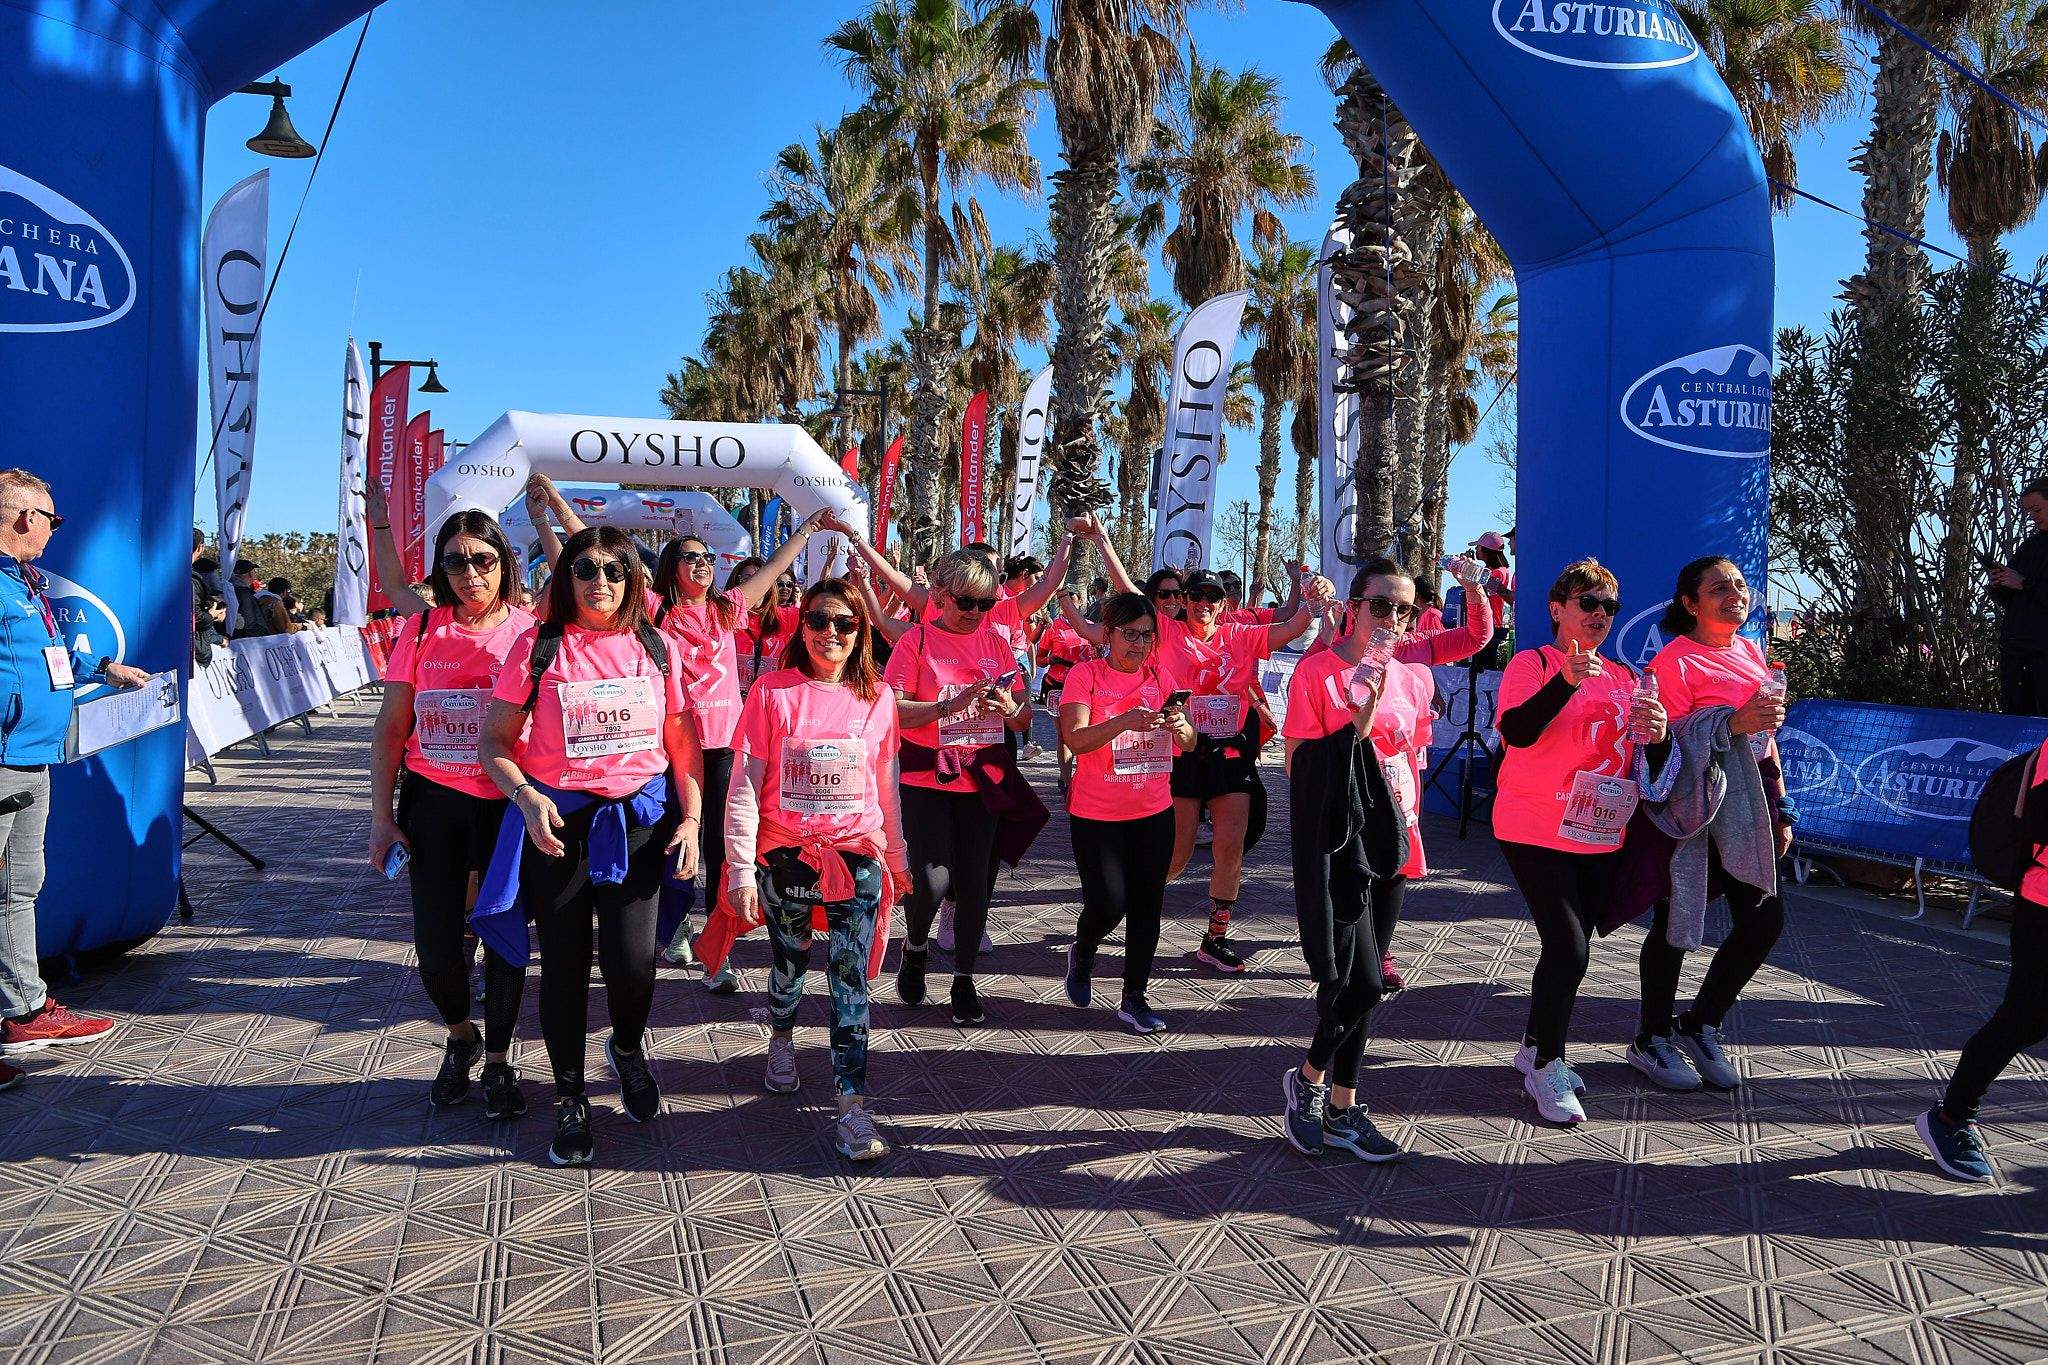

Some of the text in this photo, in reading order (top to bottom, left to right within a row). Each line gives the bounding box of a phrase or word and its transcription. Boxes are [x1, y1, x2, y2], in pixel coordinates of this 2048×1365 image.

[1510, 0, 1692, 49] ASTURIANA
[1681, 382, 1748, 395] CENTRAL
[570, 430, 746, 469] OYSHO
[1163, 340, 1222, 570] OYSHO
[457, 463, 515, 478] OYSHO
[965, 421, 980, 518] Santander
[412, 438, 424, 521] Santander
[793, 475, 843, 488] OYSHO
[423, 660, 461, 669] OYSHO
[596, 708, 631, 724] 016
[1211, 717, 1229, 727] 016
[446, 722, 479, 735] 016
[605, 725, 622, 733] 7992
[577, 744, 607, 753] OYSHO
[1132, 740, 1155, 750] 016
[1900, 760, 1961, 775] CENTRAL
[809, 773, 841, 786] 016
[1104, 773, 1131, 783] CARRERA
[789, 801, 815, 810] OYSHO
[1593, 806, 1617, 820] 016
